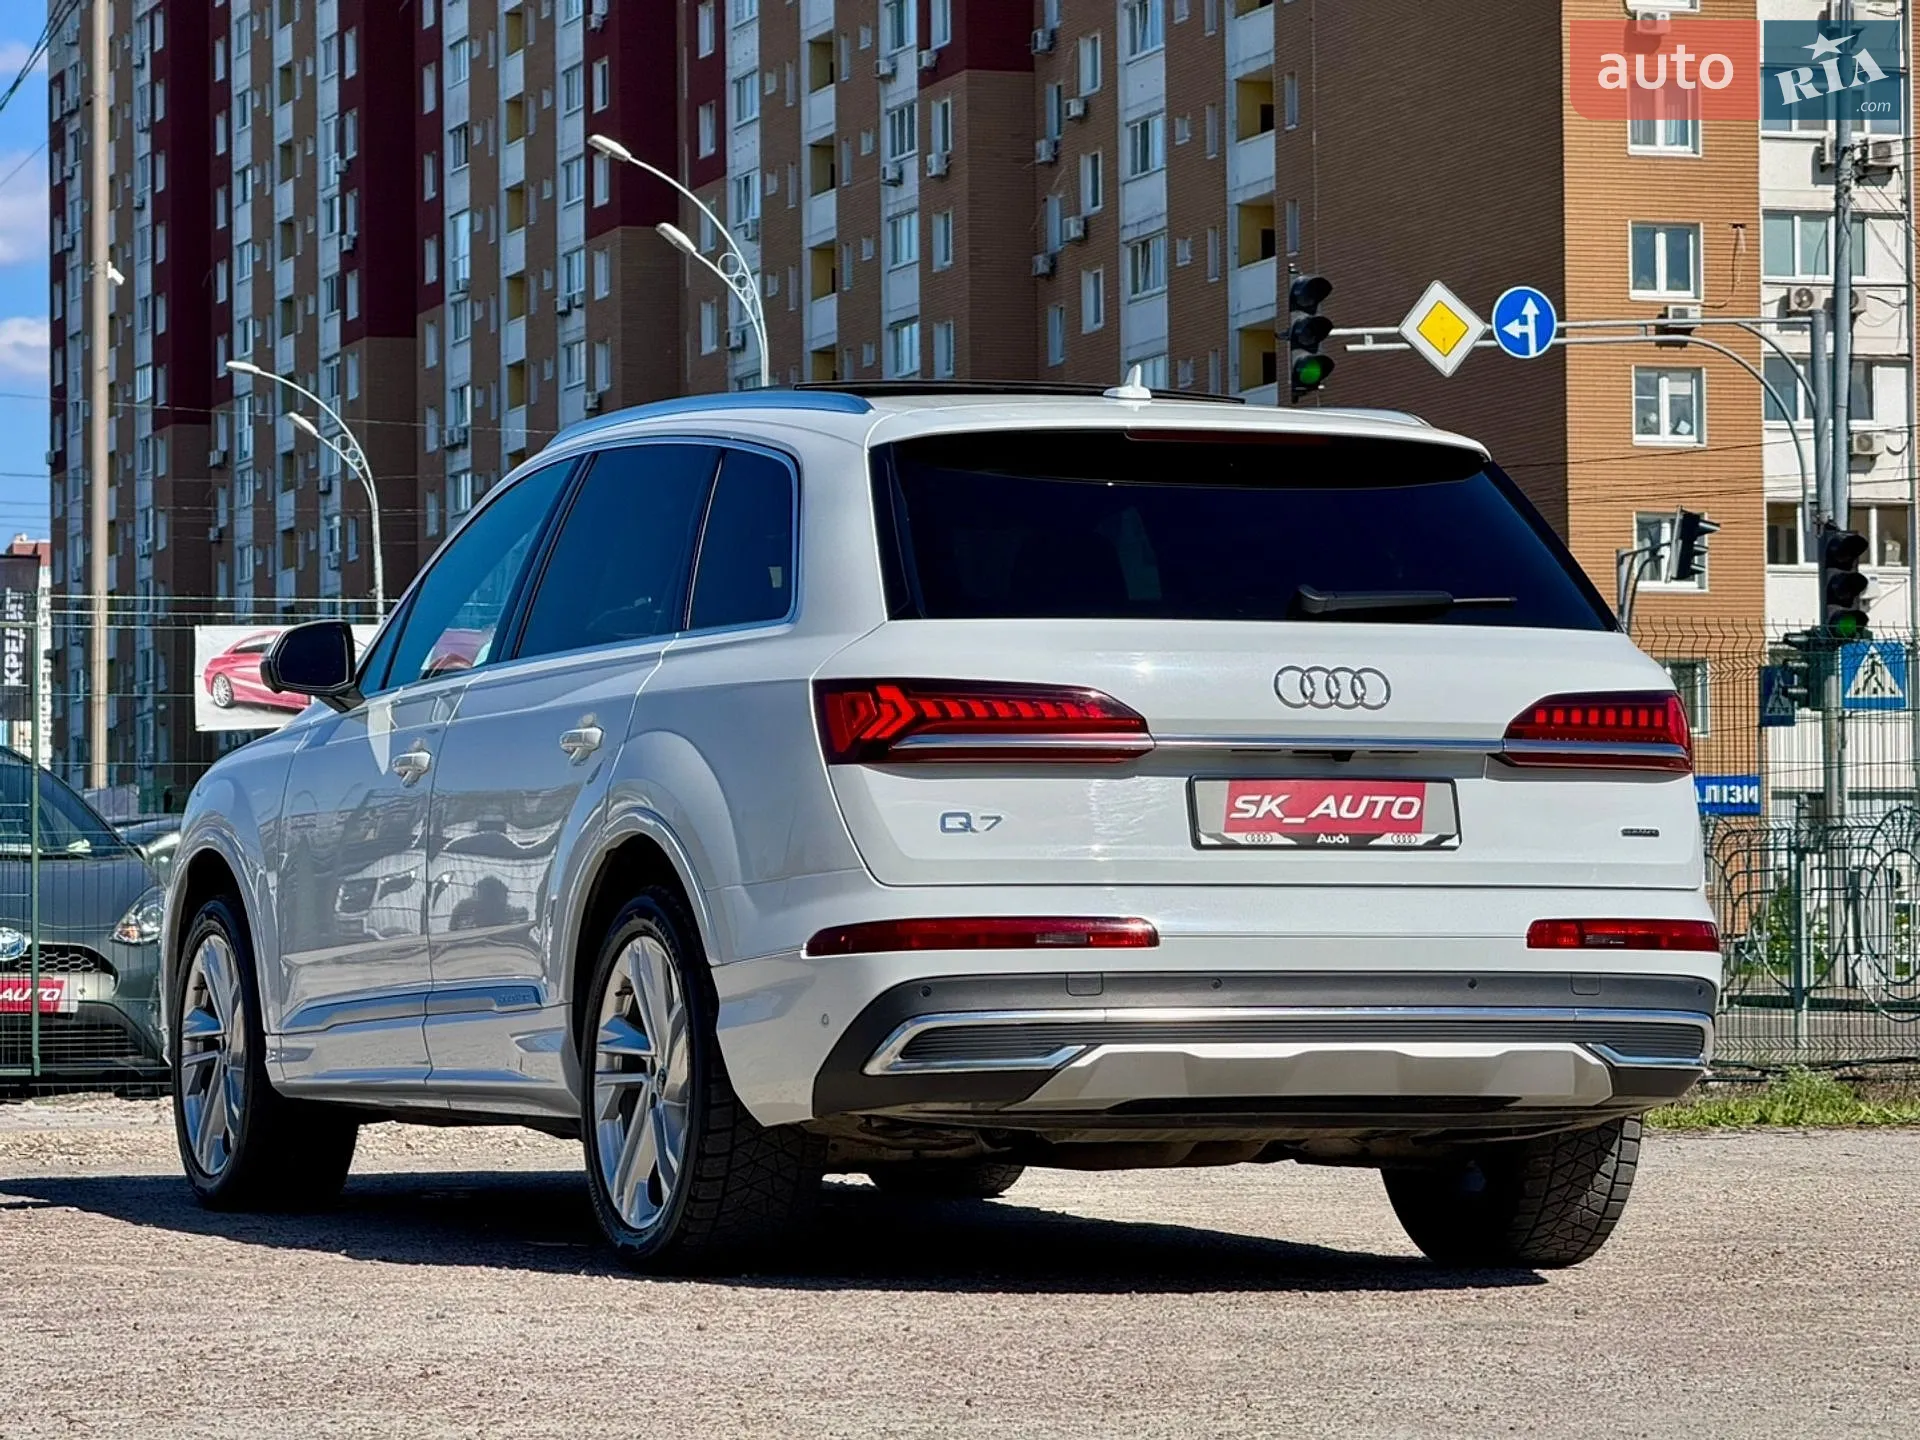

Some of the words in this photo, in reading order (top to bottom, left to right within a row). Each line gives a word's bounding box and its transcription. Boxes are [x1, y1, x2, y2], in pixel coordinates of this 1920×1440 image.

[4, 587, 26, 687] КРЕДИТ
[1695, 784, 1759, 804] ЛІЗИ
[1229, 794, 1422, 824] SK_AUTO
[940, 811, 1003, 834] Q7
[1316, 832, 1350, 844] Audi
[0, 987, 61, 1002] AUTO
